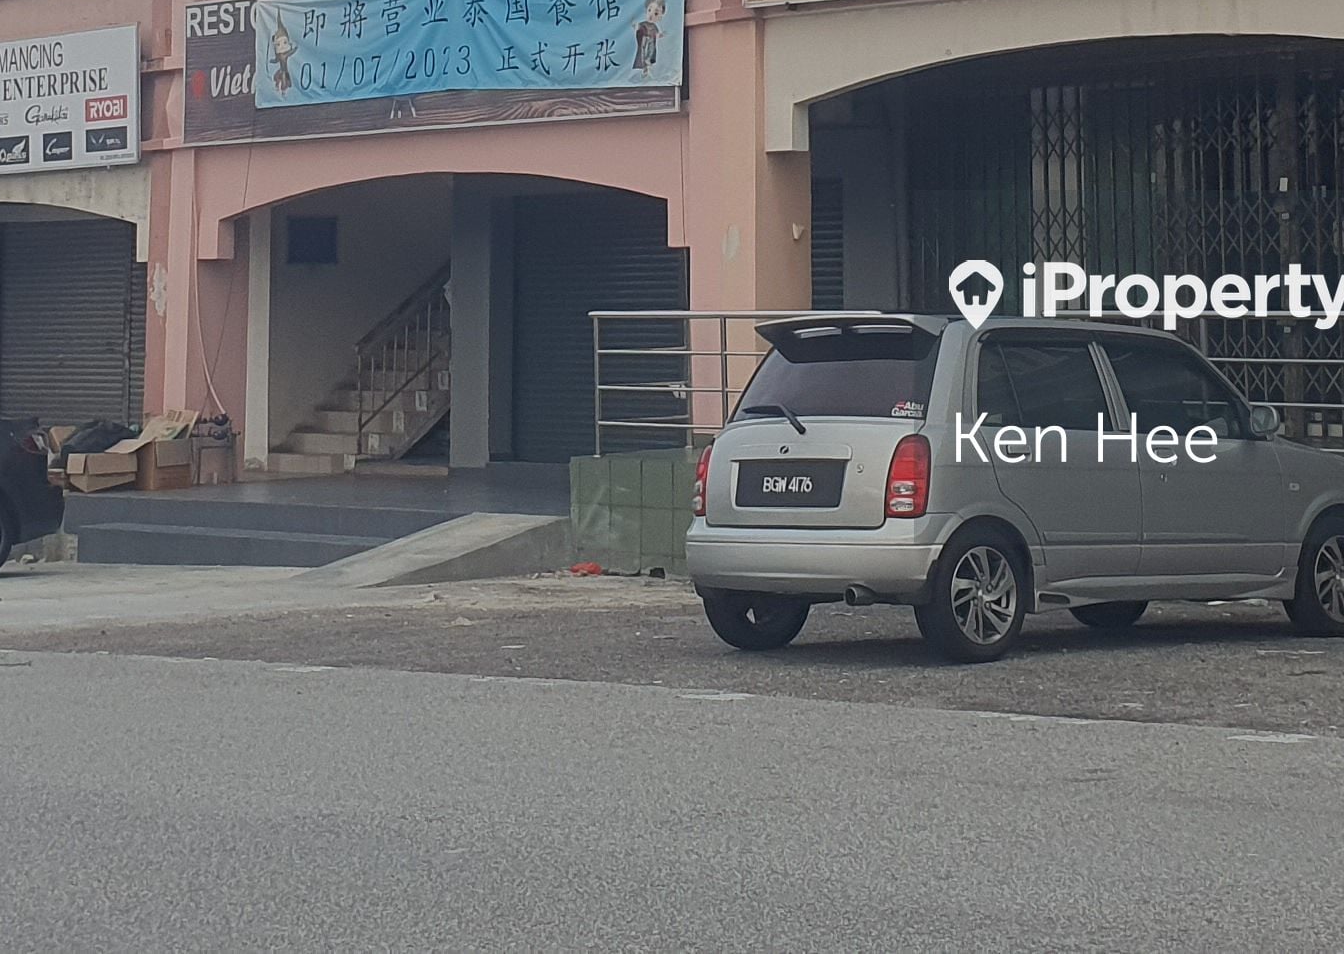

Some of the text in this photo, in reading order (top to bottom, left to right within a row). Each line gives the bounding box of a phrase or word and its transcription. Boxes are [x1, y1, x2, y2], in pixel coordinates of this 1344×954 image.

[299, 38, 622, 91] 01/07/2023 正式开张
[3, 67, 109, 102] ENTERPRISE
[89, 98, 124, 119] RYOBI
[762, 476, 813, 493] BGW 4176
